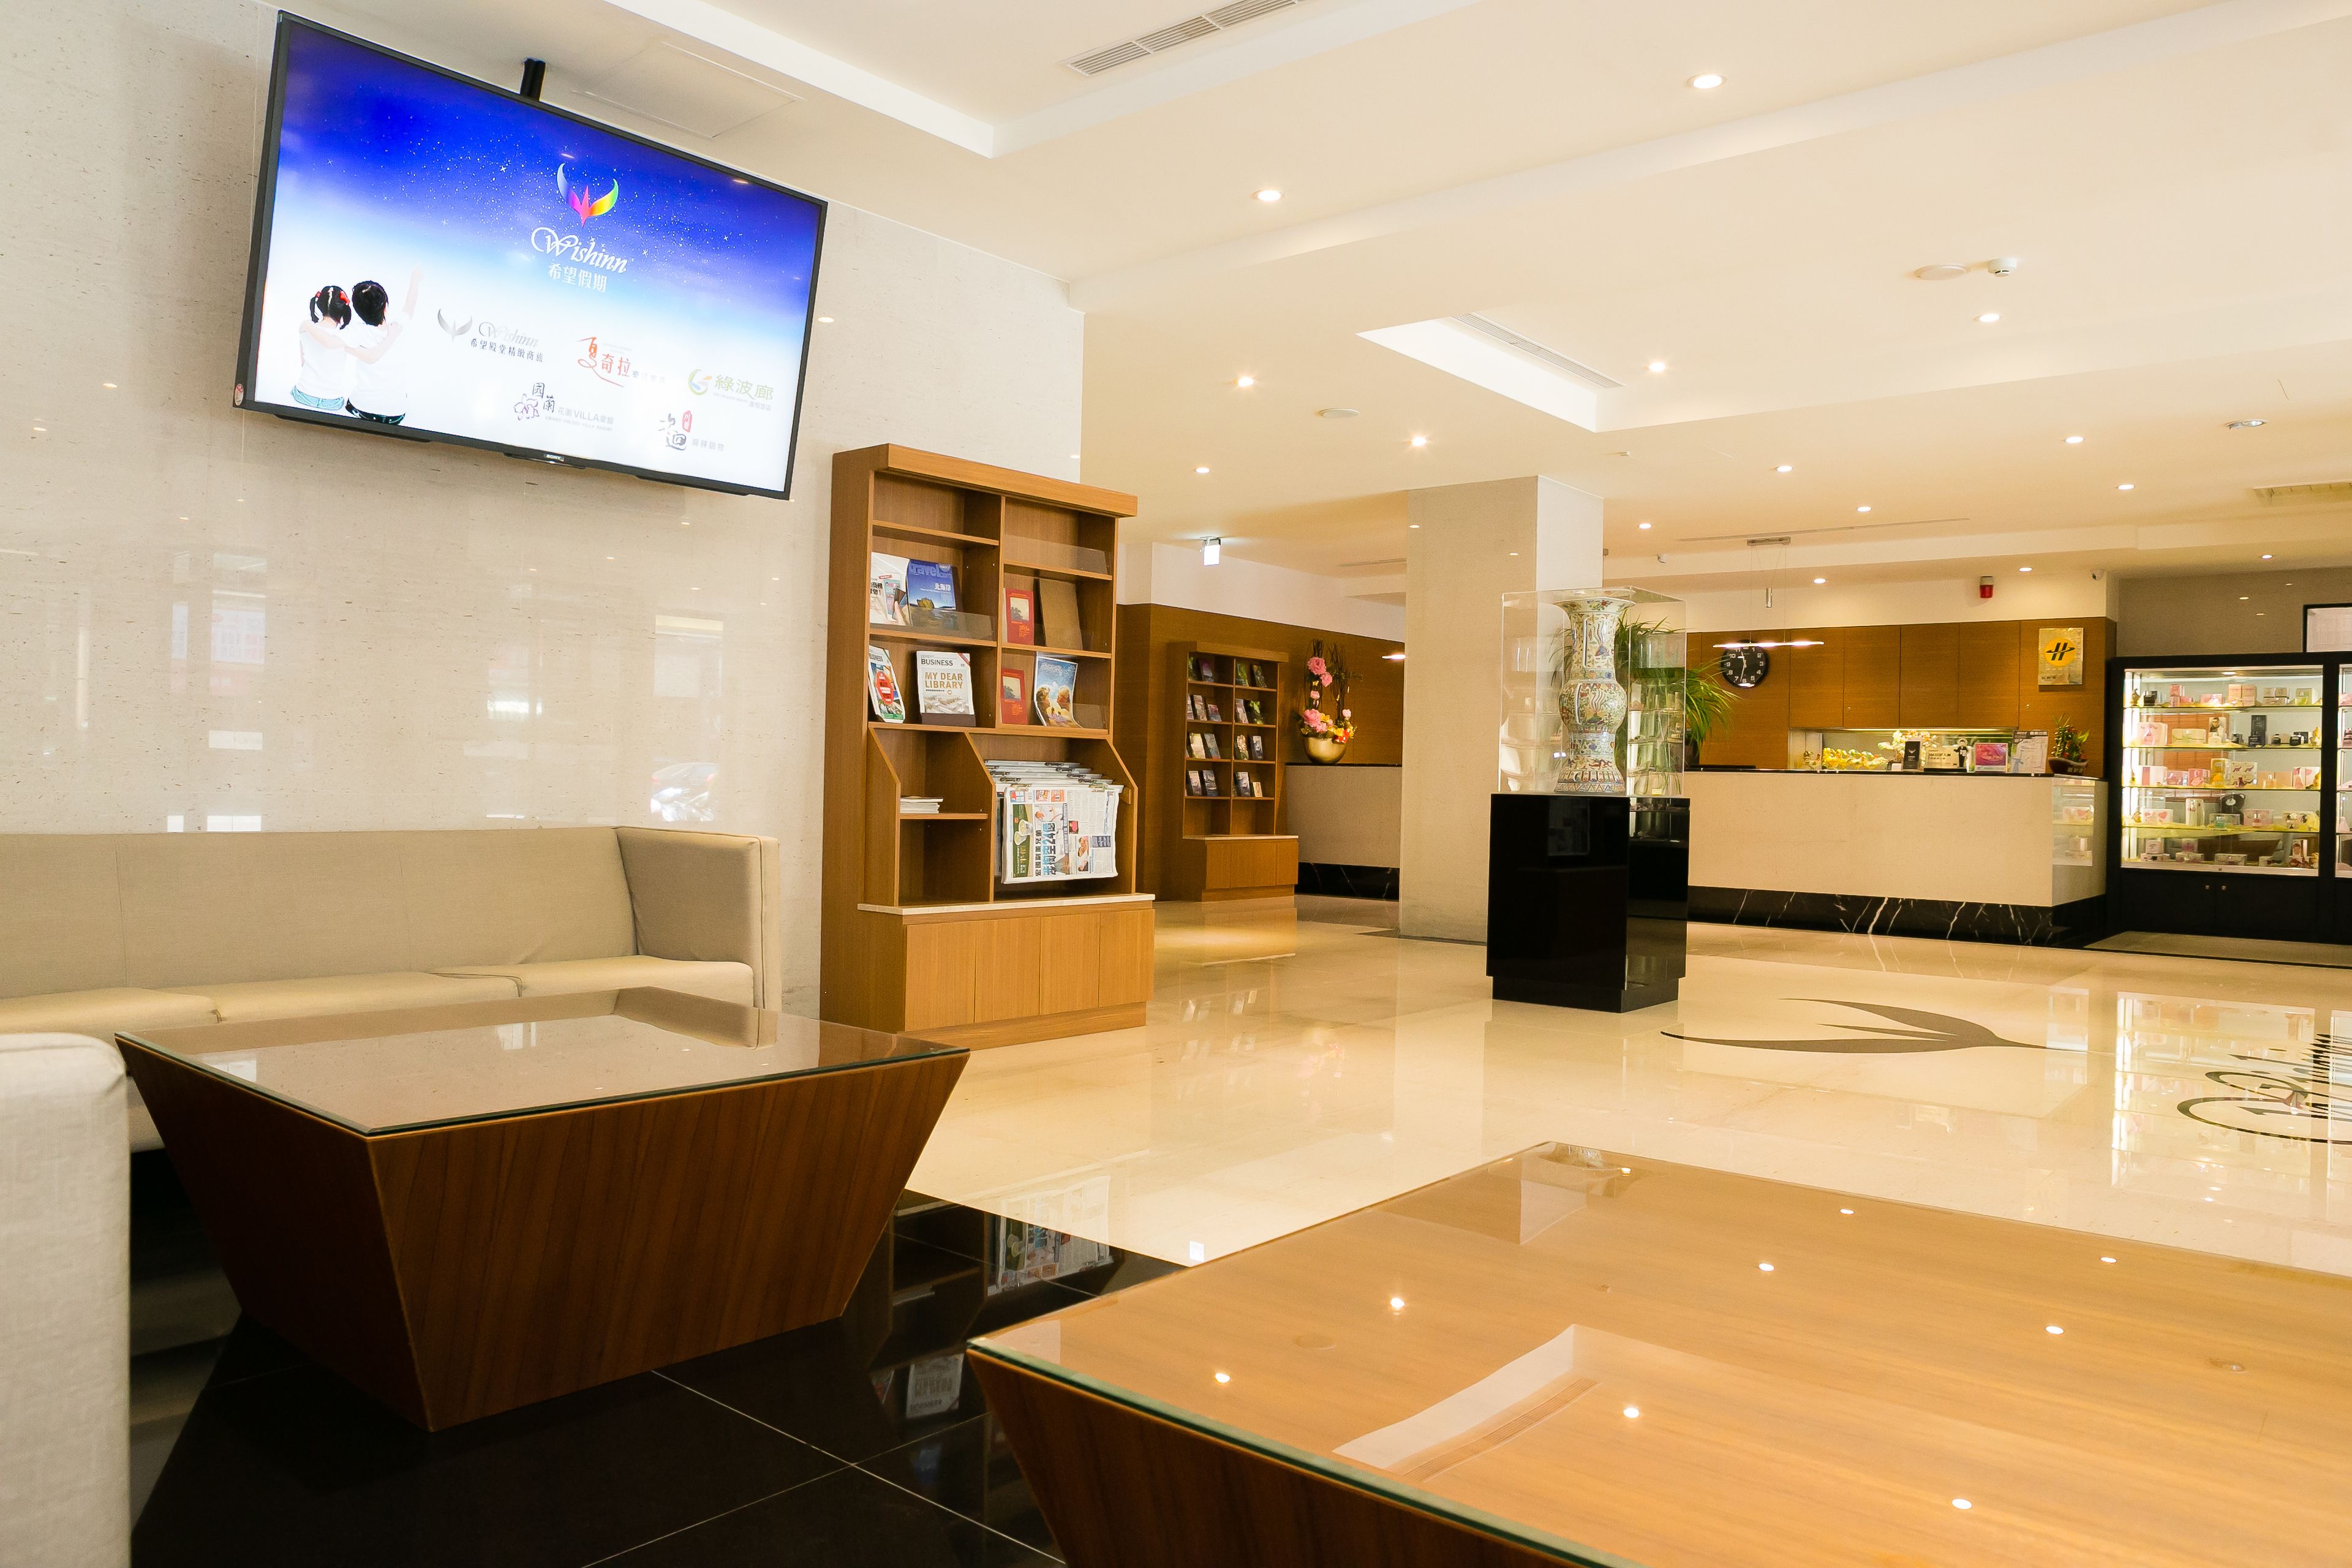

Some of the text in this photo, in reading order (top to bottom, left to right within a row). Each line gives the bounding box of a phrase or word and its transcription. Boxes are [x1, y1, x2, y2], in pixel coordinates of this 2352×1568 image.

[531, 227, 628, 273] Wishinn
[548, 263, 608, 293] 希望假期
[470, 338, 543, 362] 希望殿堂精緻商旅
[715, 374, 774, 400] 綠波廊
[925, 680, 963, 689] LIBRARY
